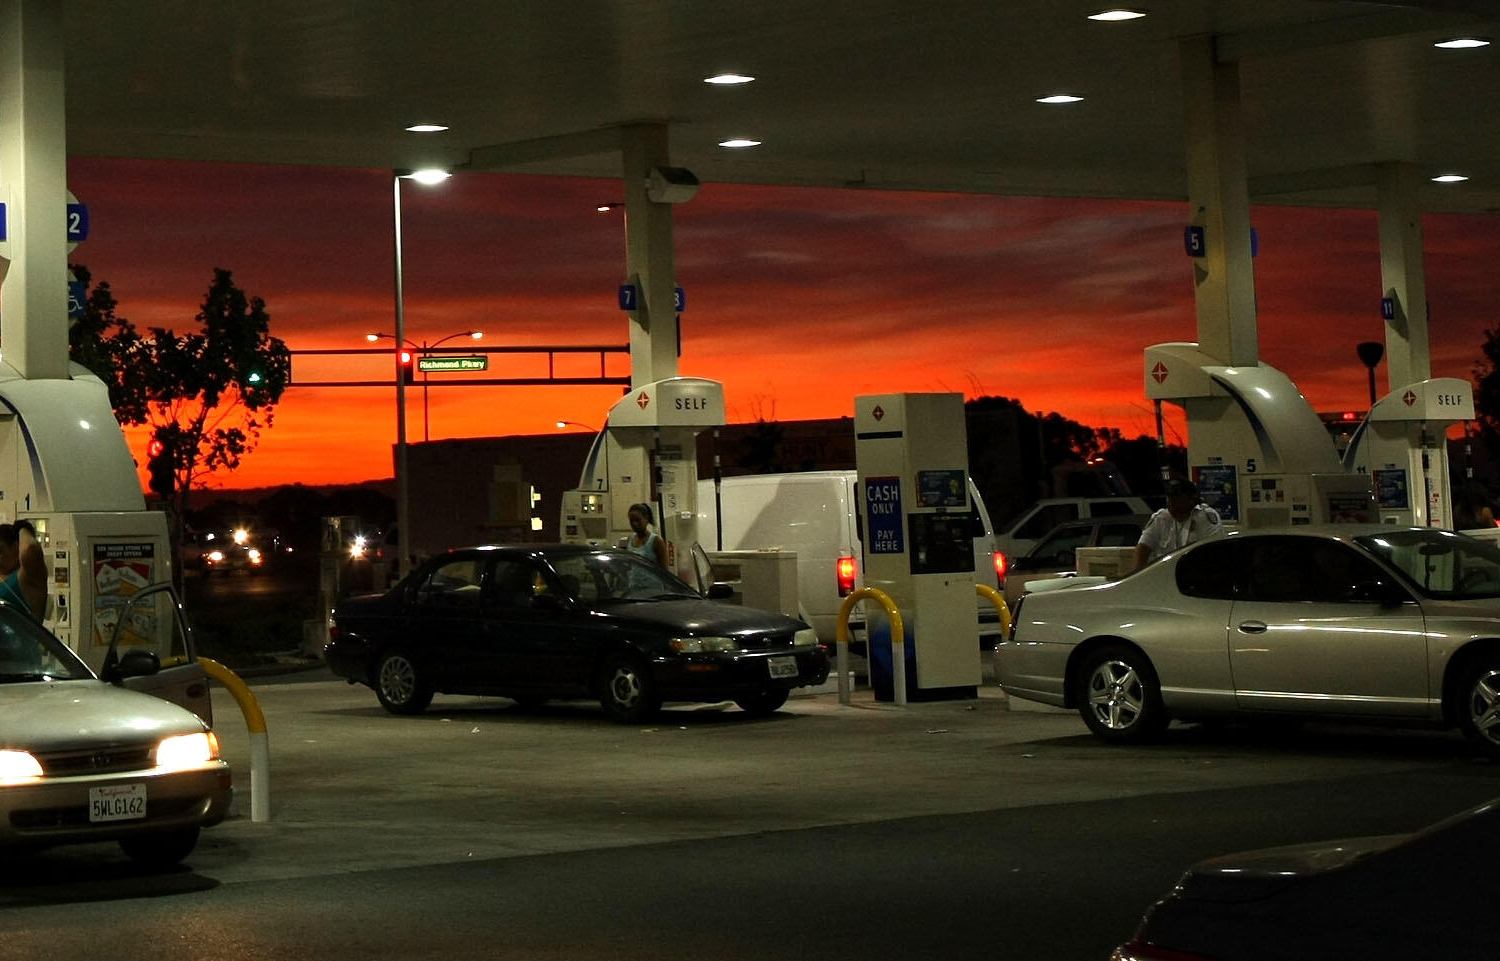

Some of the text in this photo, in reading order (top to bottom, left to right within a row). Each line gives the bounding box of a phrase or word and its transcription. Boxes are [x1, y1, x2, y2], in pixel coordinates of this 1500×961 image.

[68, 212, 81, 234] 2
[1191, 233, 1199, 250] 5
[624, 290, 632, 304] 7
[1383, 301, 1393, 315] 11
[420, 360, 484, 369] Richmond Pkwy
[675, 398, 707, 410] SELF
[1438, 395, 1462, 405] SELF
[1247, 458, 1256, 473] 5
[597, 478, 603, 490] 7
[867, 485, 899, 501] CASH
[25, 493, 30, 510] 1
[872, 503, 895, 514] ONLY
[877, 529, 895, 540] PAY
[875, 541, 899, 552] HERE
[93, 797, 143, 817] 5WLG162
